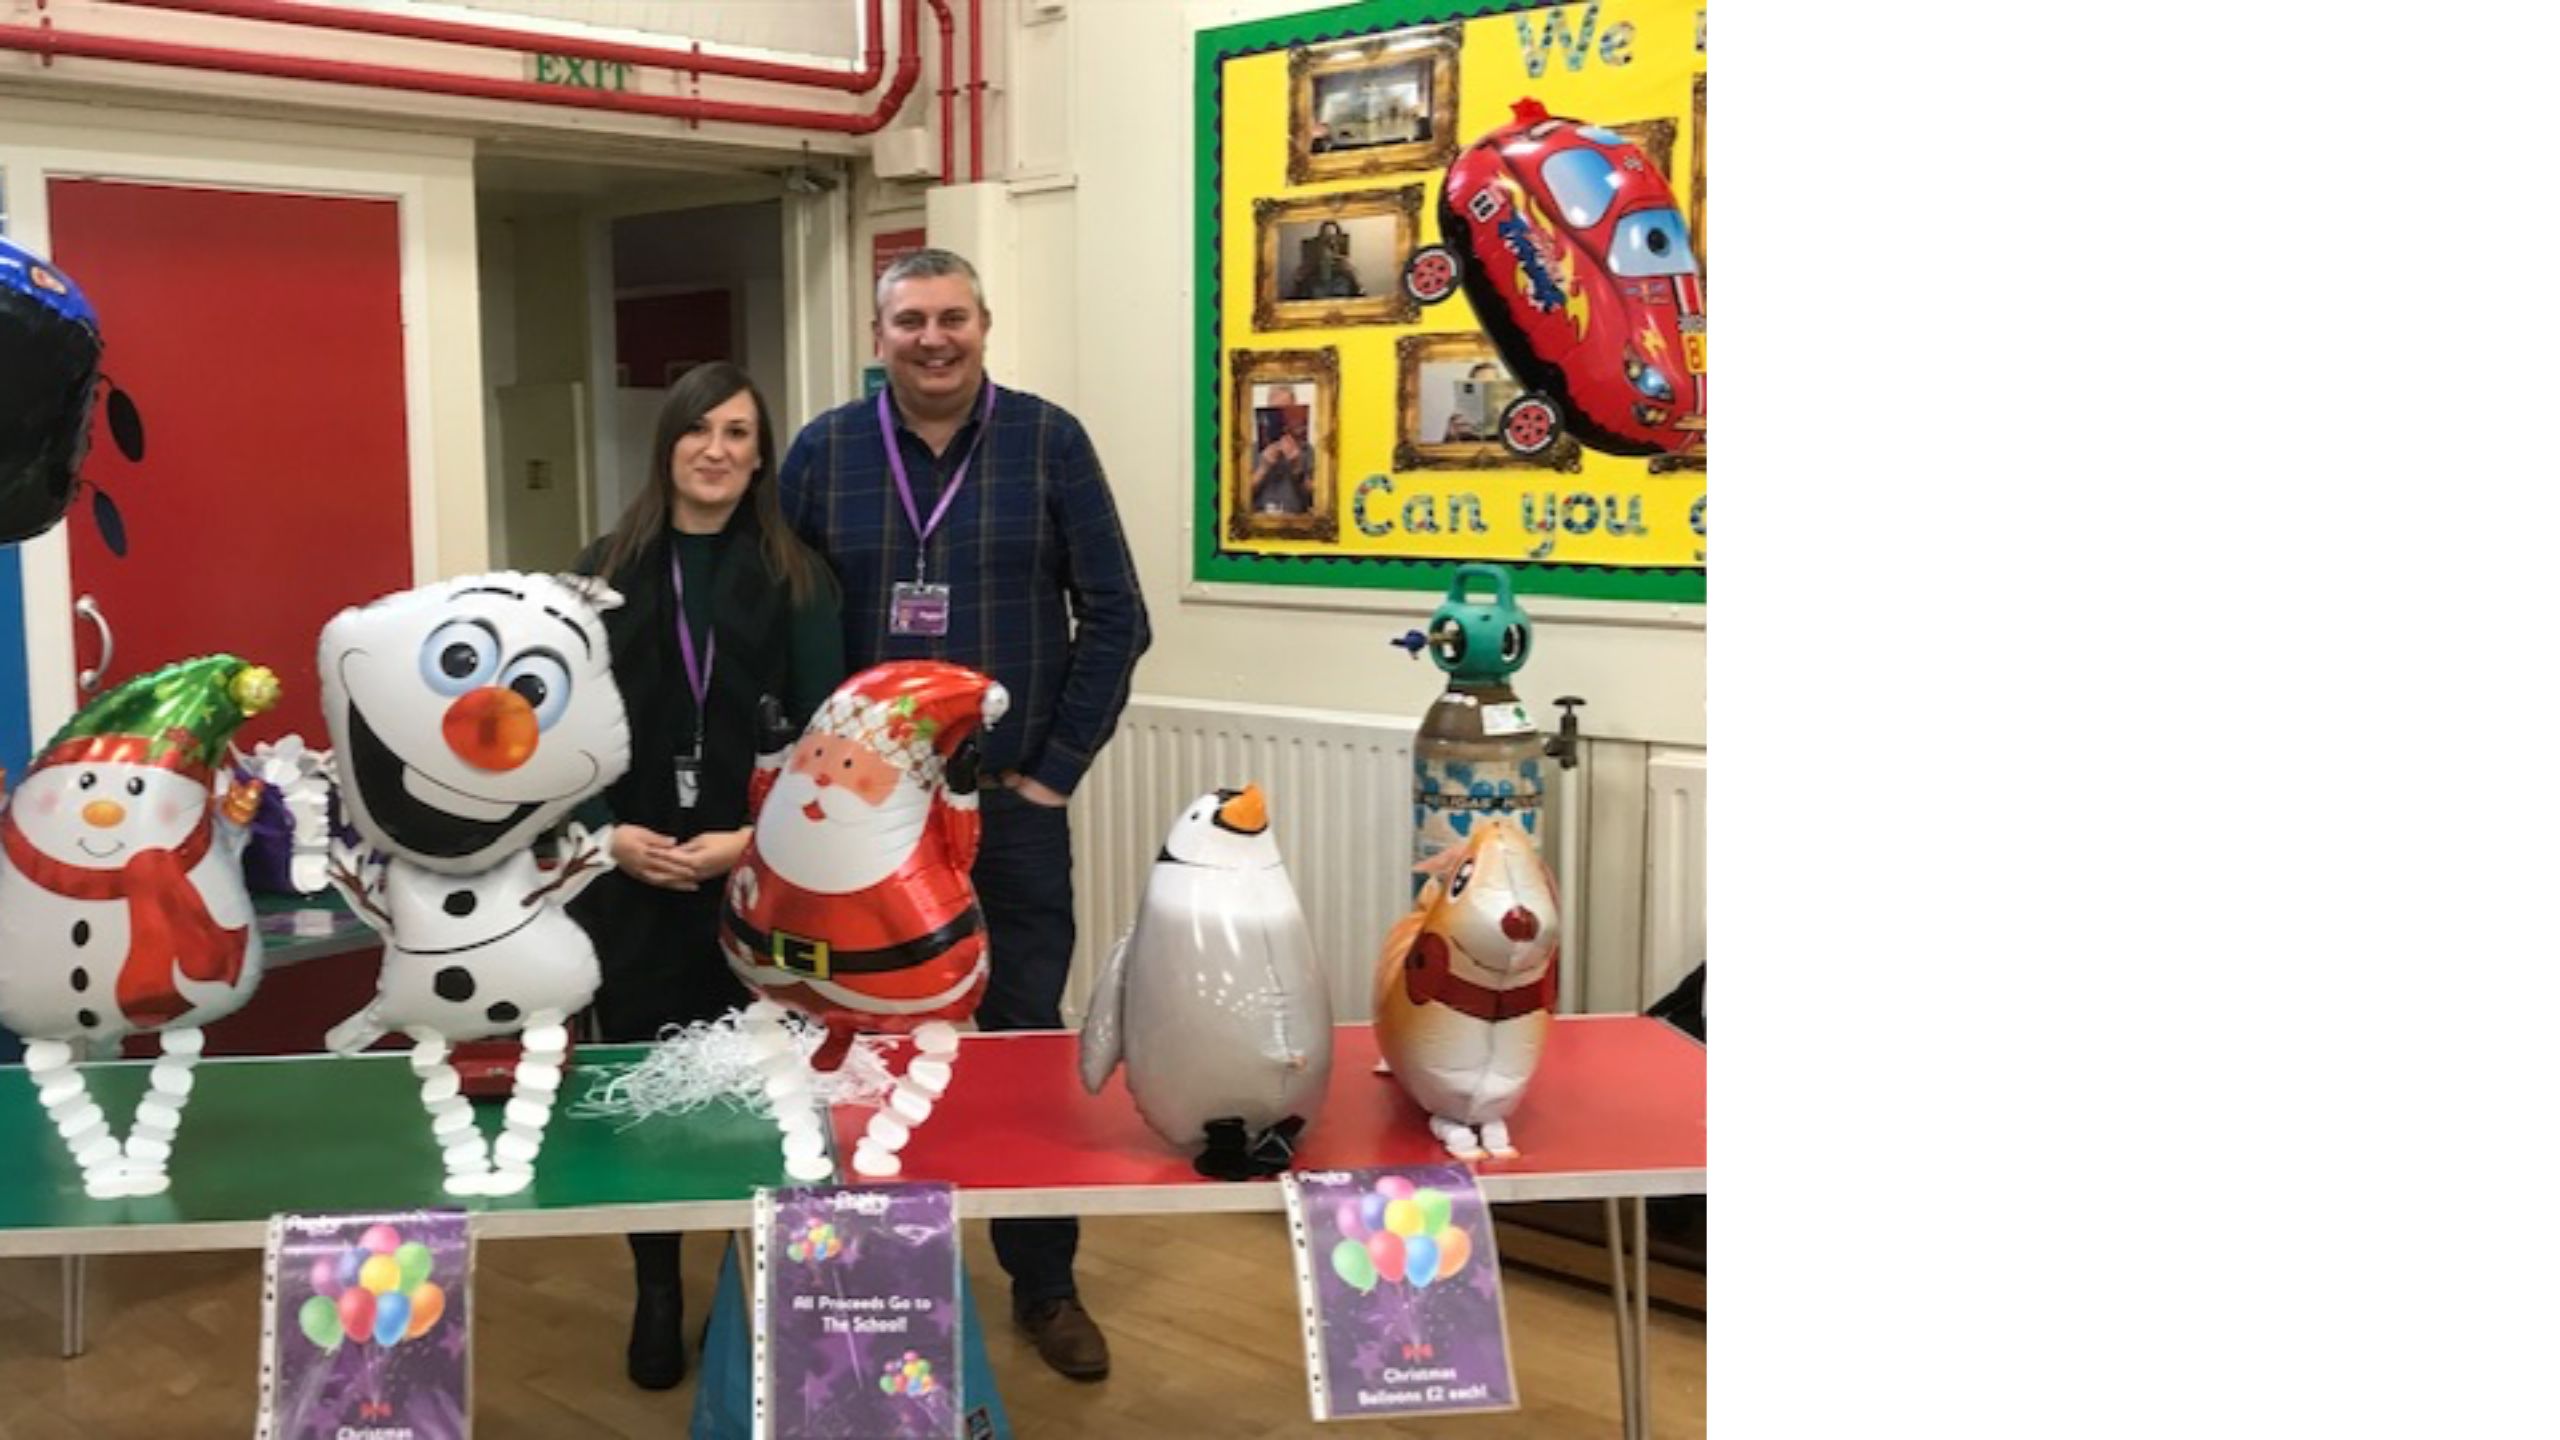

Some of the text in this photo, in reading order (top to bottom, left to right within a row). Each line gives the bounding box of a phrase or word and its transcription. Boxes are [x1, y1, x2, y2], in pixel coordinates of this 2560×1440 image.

[1515, 5, 1635, 78] We
[535, 53, 634, 91] EXIT
[1354, 474, 1488, 536] Can
[1521, 493, 1648, 559] you
[793, 1295, 933, 1310] All Proceeds Go to
[822, 1316, 849, 1333] The
[1384, 1367, 1457, 1383] Christmas
[1357, 1383, 1488, 1406] Balloons £2 each!
[337, 1426, 414, 1440] Christmas
